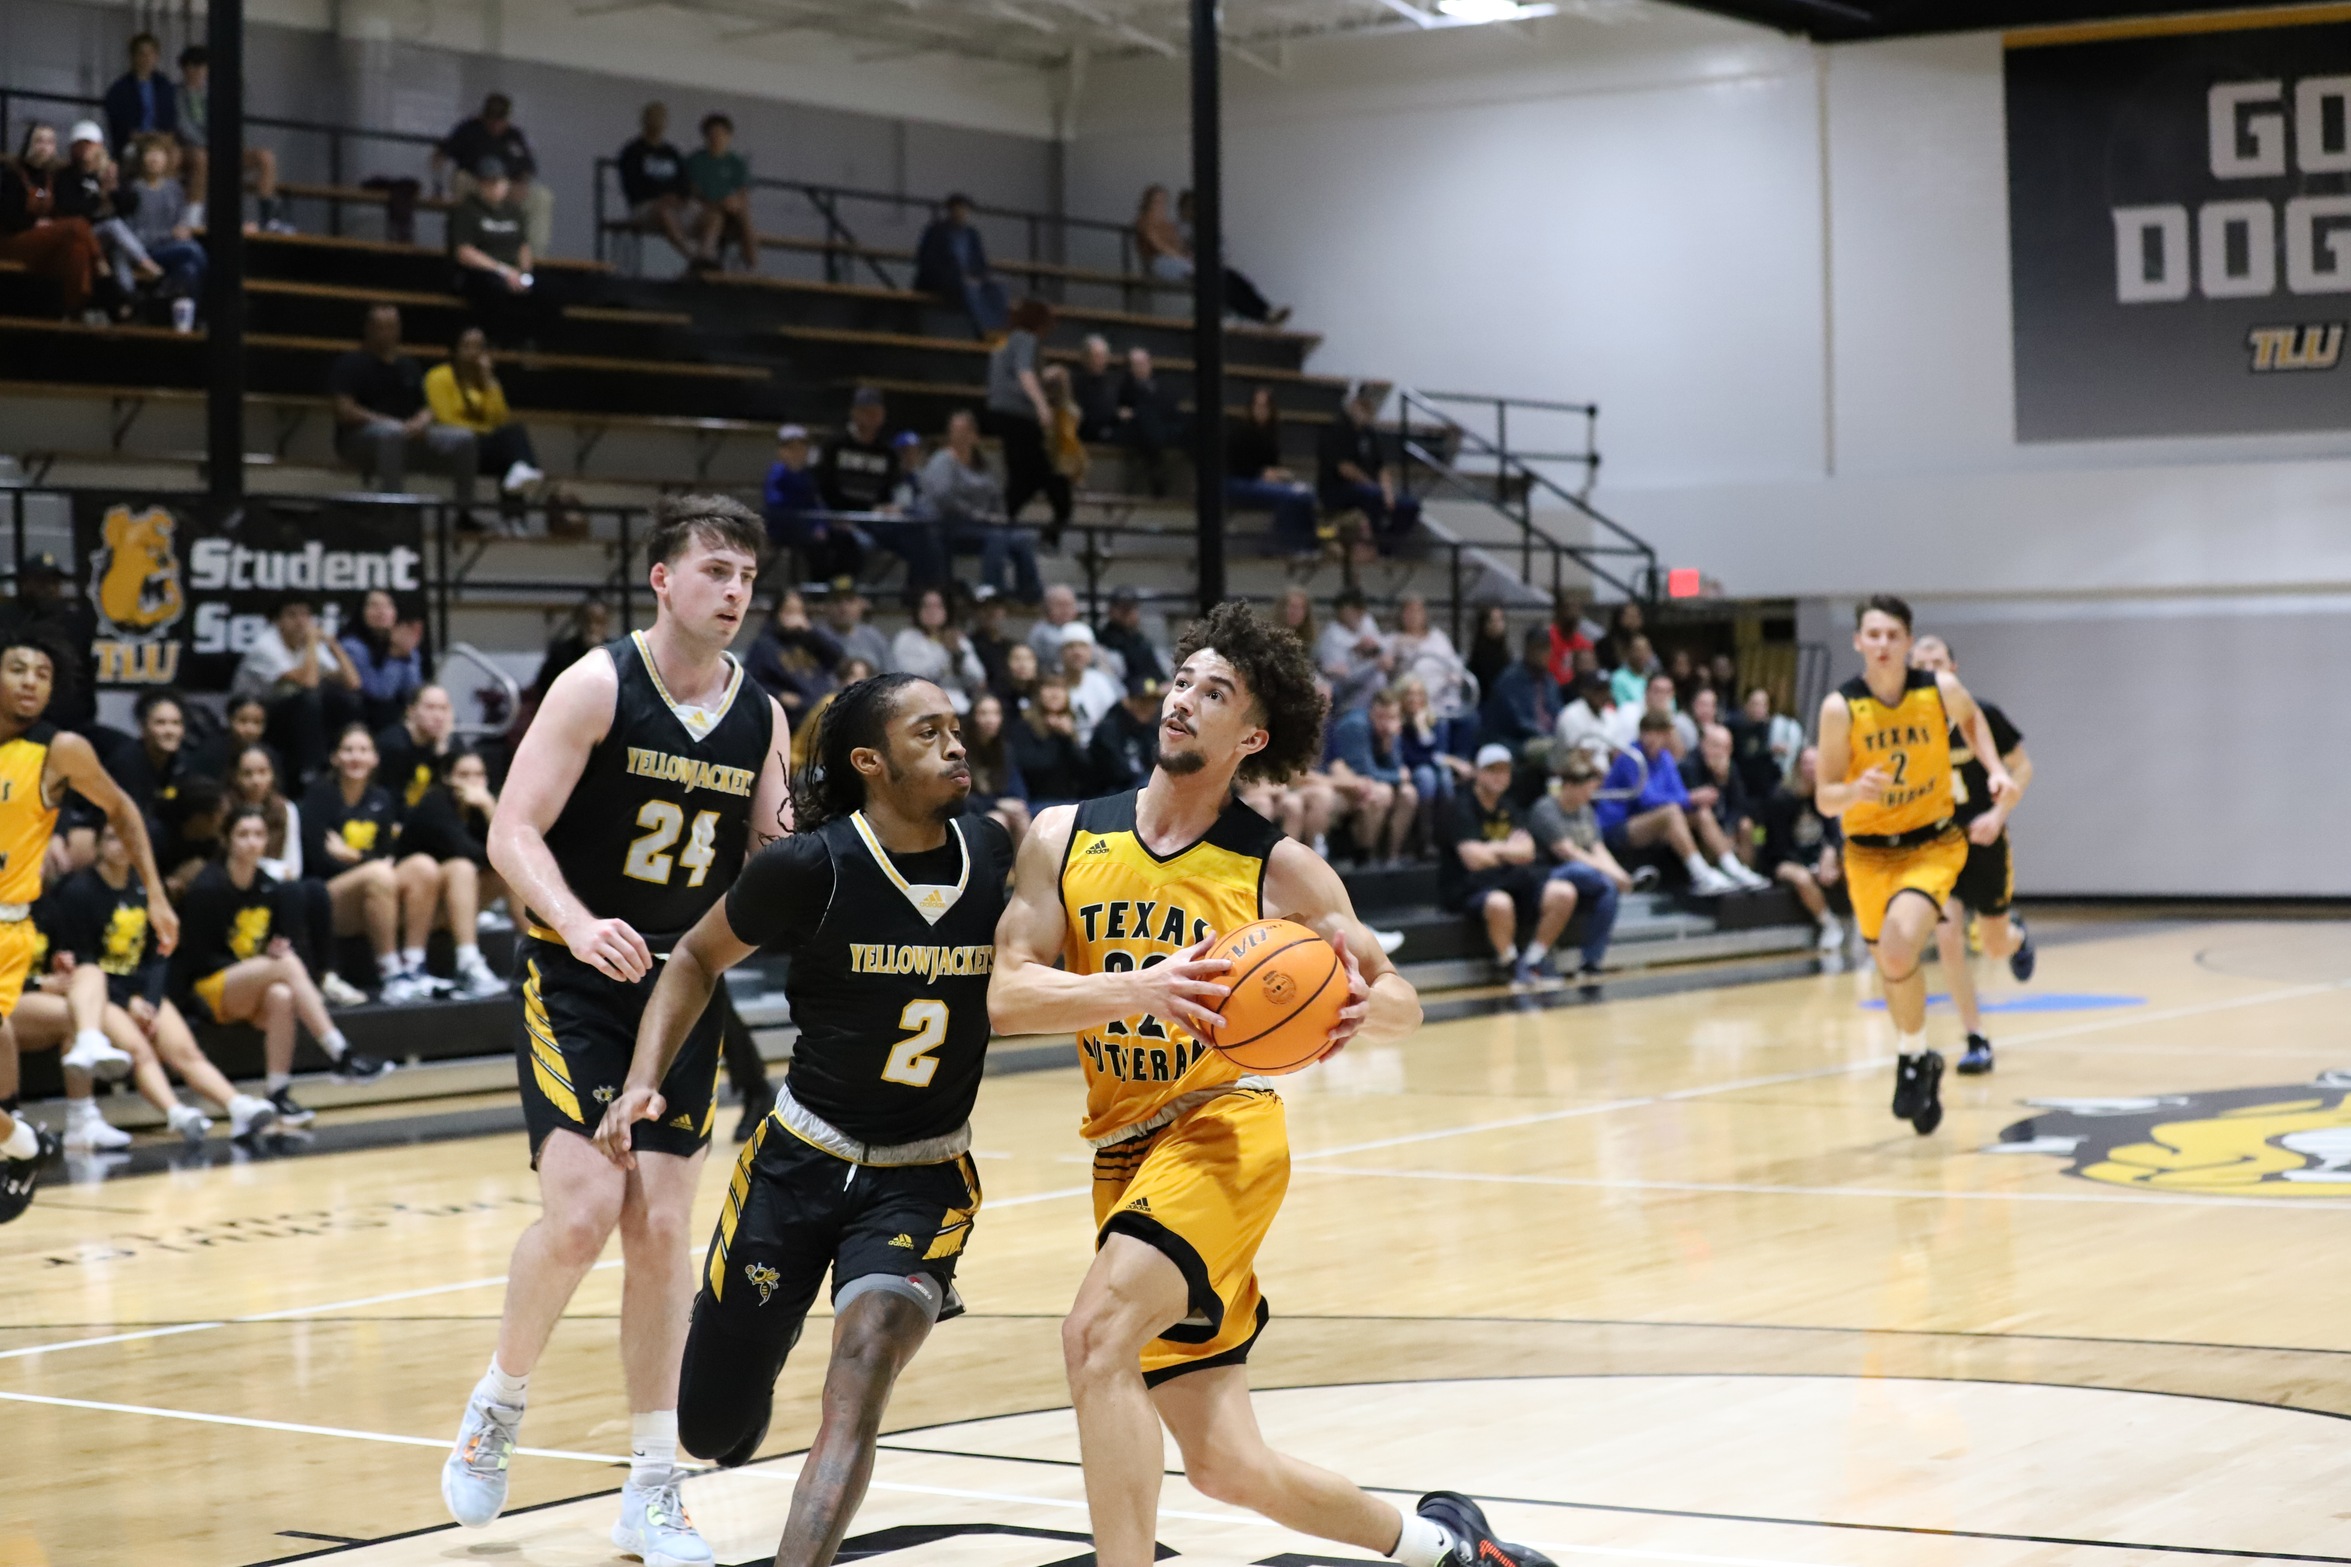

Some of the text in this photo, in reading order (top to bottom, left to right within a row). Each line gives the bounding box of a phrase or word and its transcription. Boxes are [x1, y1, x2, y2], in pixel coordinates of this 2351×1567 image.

[2207, 75, 2351, 180] GO
[2250, 324, 2344, 372] TLU
[189, 536, 420, 590] Student
[93, 636, 181, 684] TLU
[1864, 727, 1931, 752] TEXAS
[1890, 752, 1908, 786] 2
[622, 799, 722, 888] 24
[919, 900, 946, 908] adidas
[880, 998, 950, 1088] 2
[1125, 1203, 1152, 1212] adidas
[888, 1240, 914, 1250] adidas
